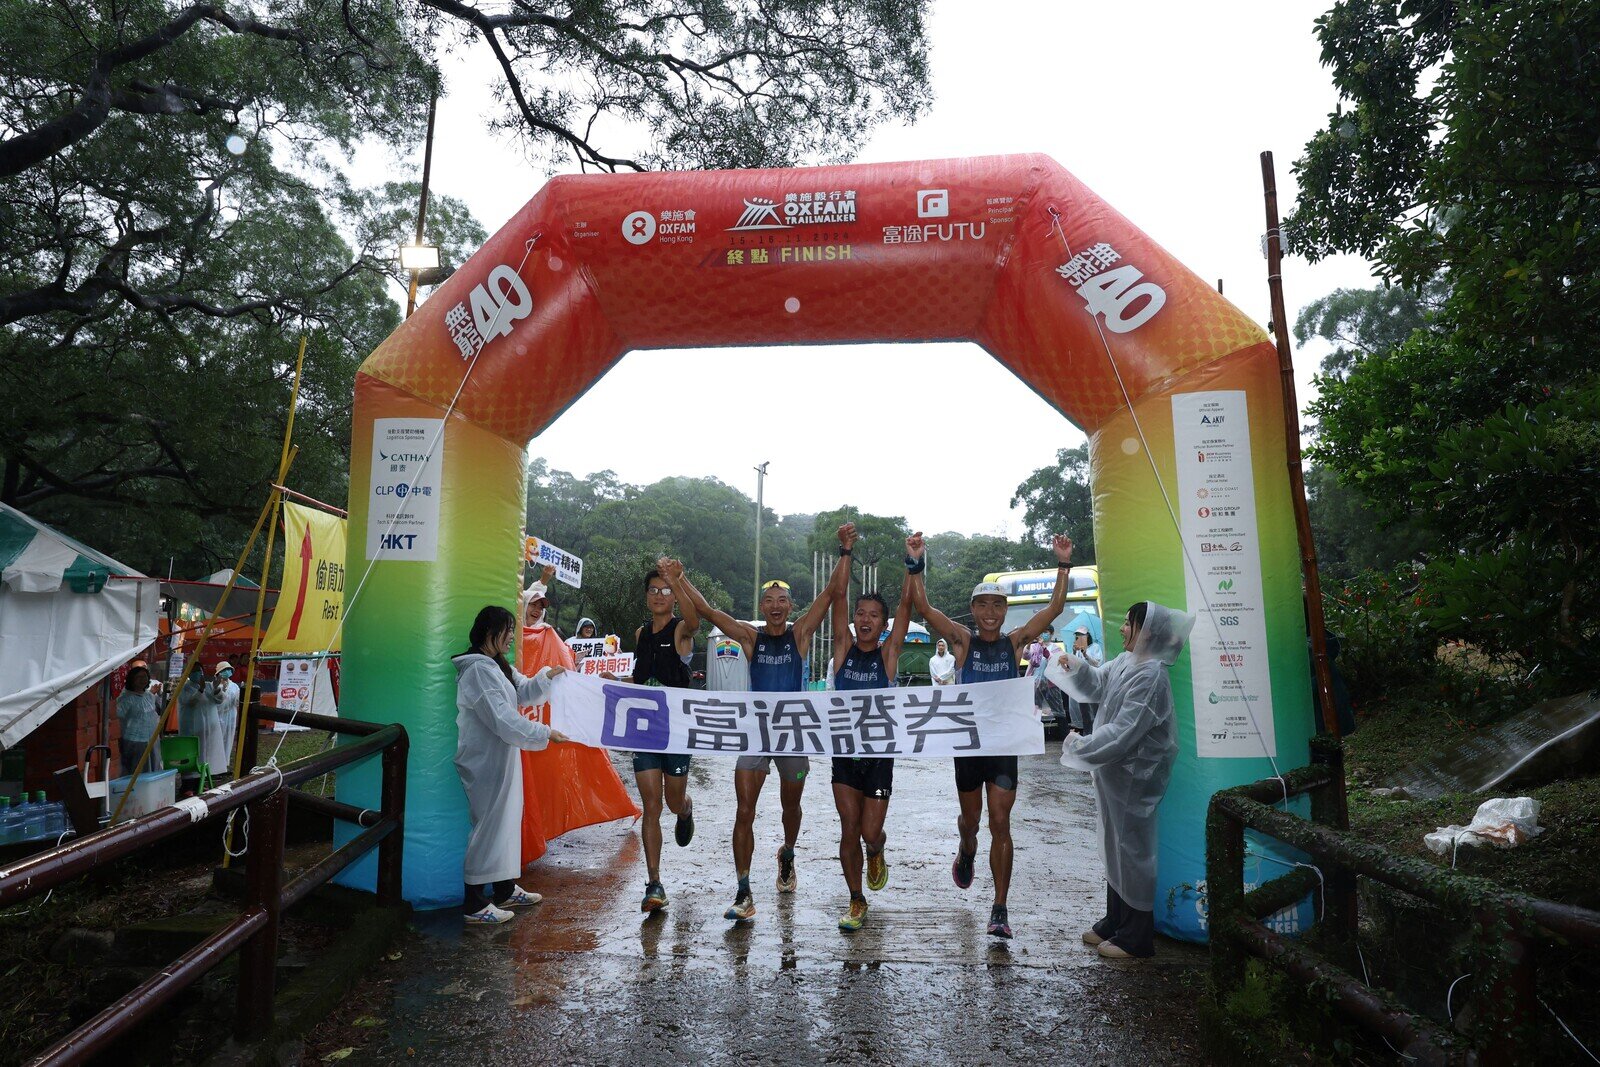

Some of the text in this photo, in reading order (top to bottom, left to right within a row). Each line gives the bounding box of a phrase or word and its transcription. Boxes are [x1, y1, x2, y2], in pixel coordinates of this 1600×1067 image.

[785, 190, 856, 202] 樂施毅行者
[660, 209, 696, 222] 樂施會
[783, 201, 856, 216] OXFAM
[785, 214, 856, 225] TRAILWALKER
[659, 223, 696, 234] OXFAM
[659, 236, 693, 244] Hong Kong
[727, 245, 851, 265] 終點 FINISH
[469, 264, 533, 344] 40
[1075, 264, 1167, 334] 40
[390, 453, 432, 462] CATHAY
[390, 464, 406, 472] 國泰
[375, 485, 432, 497] CLP 中電
[380, 534, 418, 550] HKT
[540, 544, 580, 575] 毅行精神
[322, 600, 339, 620] Rest
[1220, 616, 1239, 626] SGS
[584, 657, 631, 675] 夥伴同行!
[682, 689, 981, 755] 富途證券
